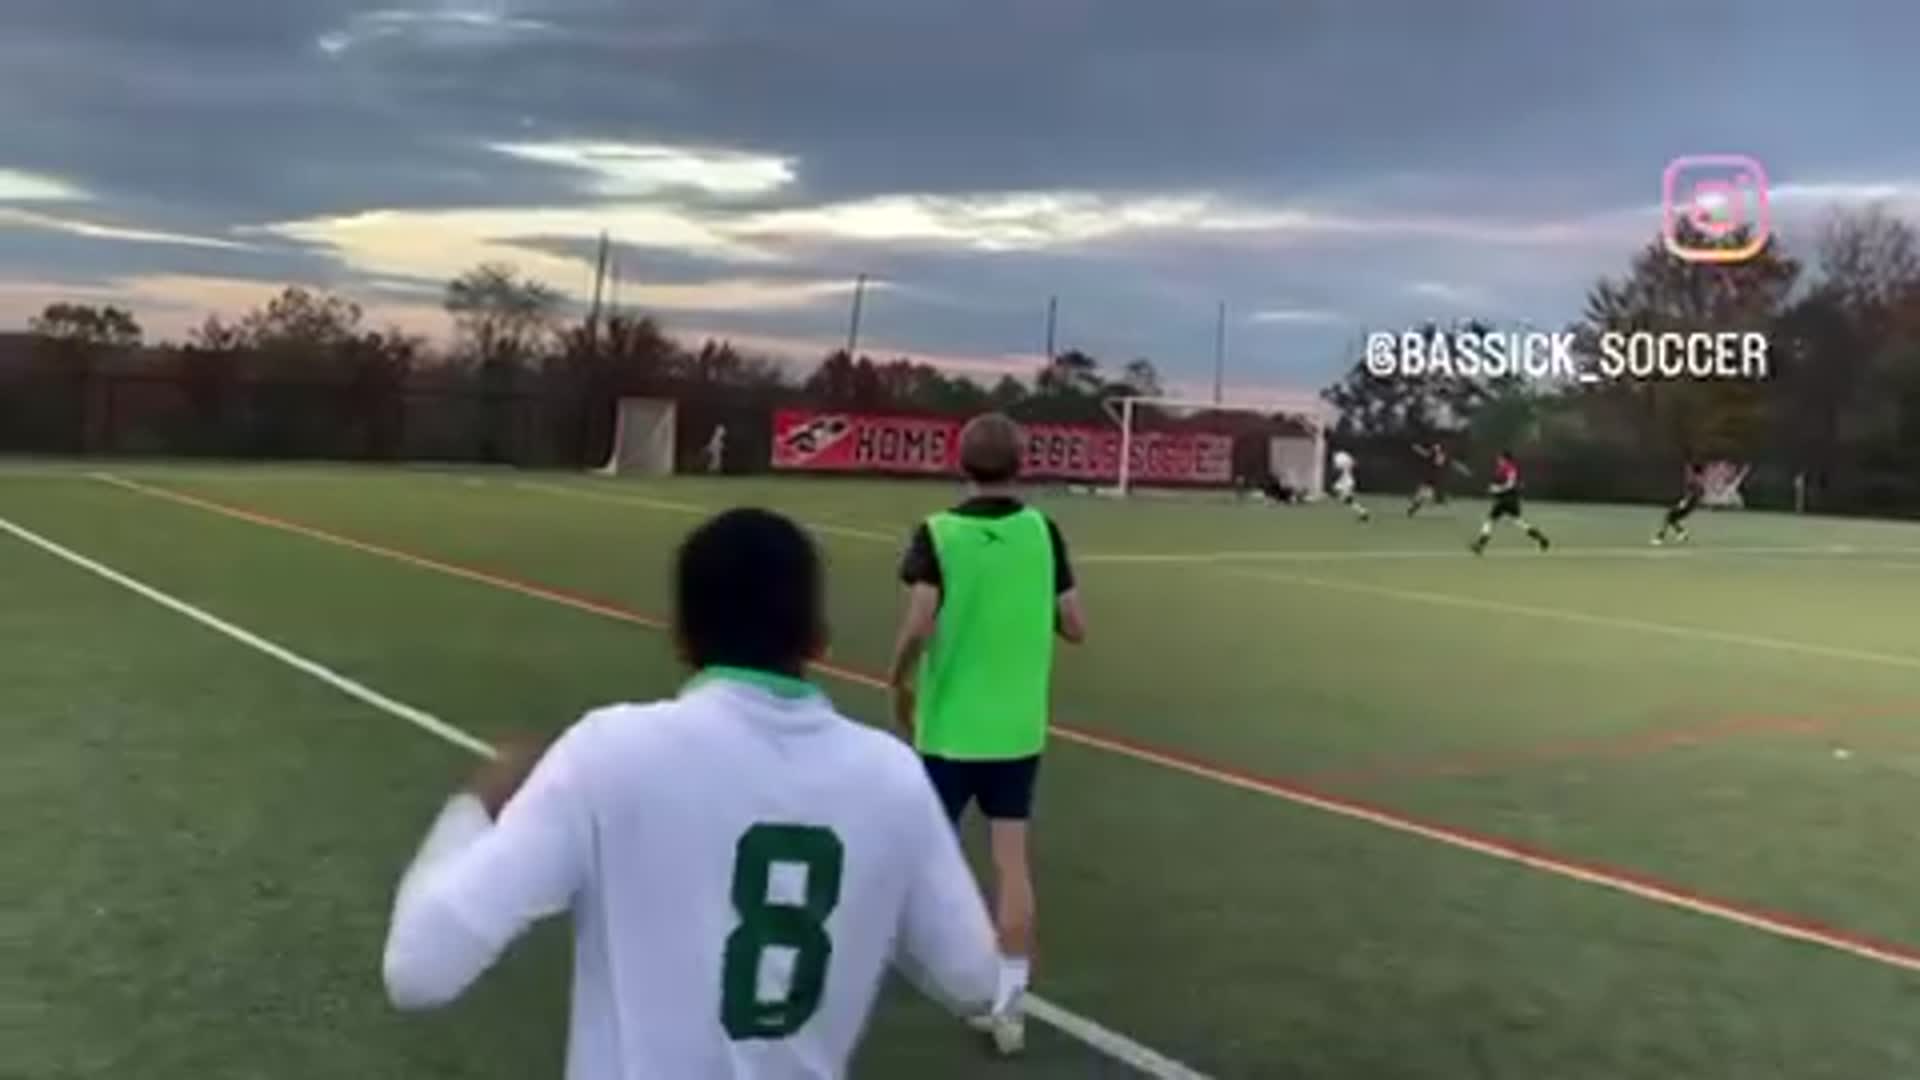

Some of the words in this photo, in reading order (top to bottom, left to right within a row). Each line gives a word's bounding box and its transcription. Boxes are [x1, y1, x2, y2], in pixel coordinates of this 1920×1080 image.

[855, 425, 945, 463] HOME
[1025, 432, 1119, 470] EBELS
[720, 822, 845, 1041] 8
